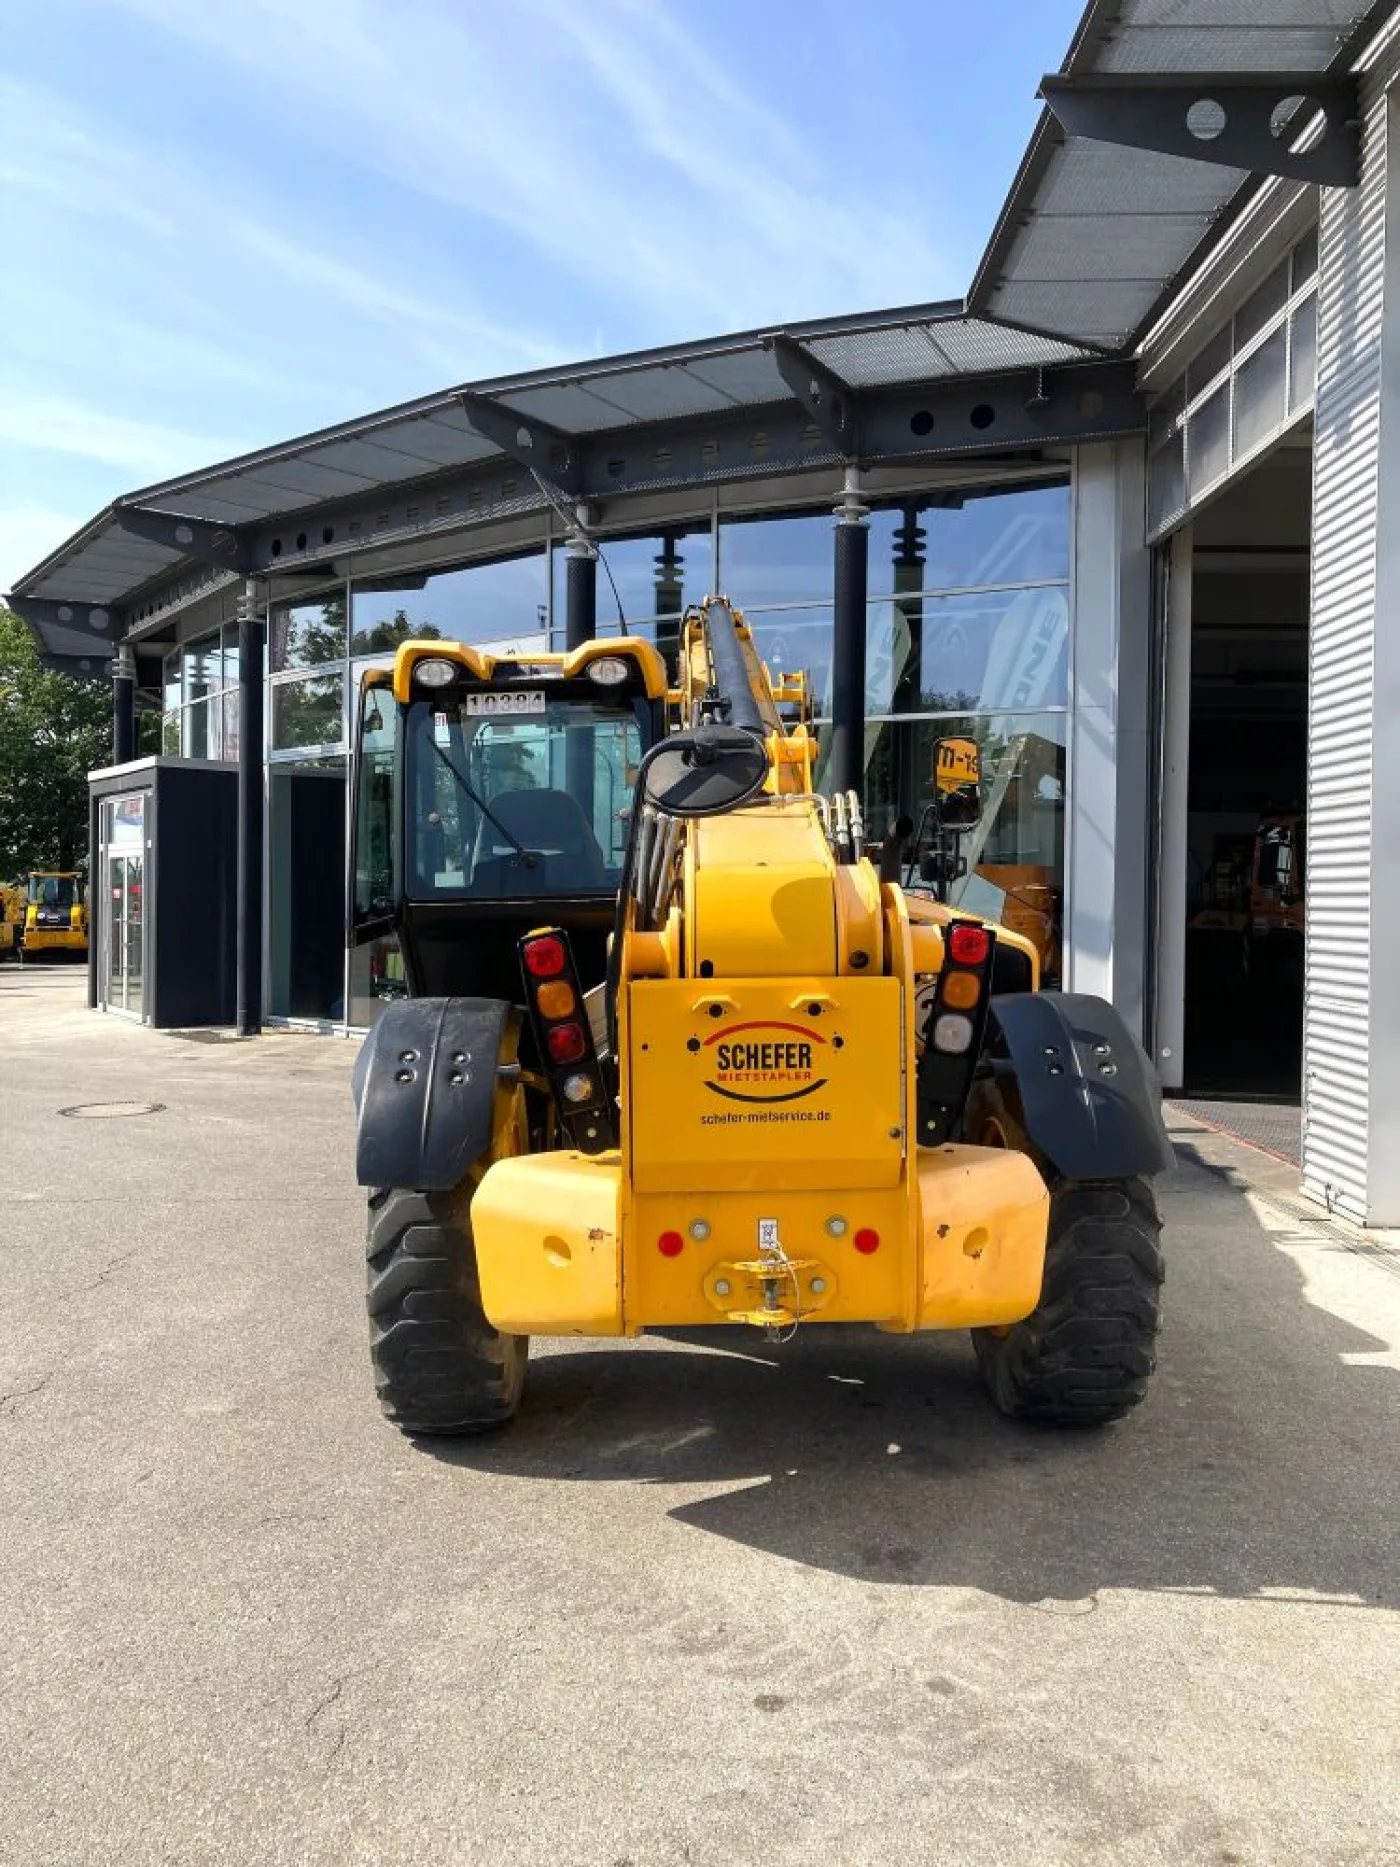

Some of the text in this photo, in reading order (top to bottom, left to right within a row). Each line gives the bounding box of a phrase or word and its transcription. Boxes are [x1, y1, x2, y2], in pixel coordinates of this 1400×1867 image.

[717, 1043, 812, 1071] SCHEFER
[717, 1071, 812, 1082] MIETSTAPLER
[701, 1110, 831, 1125] schefer-mietservice.de
